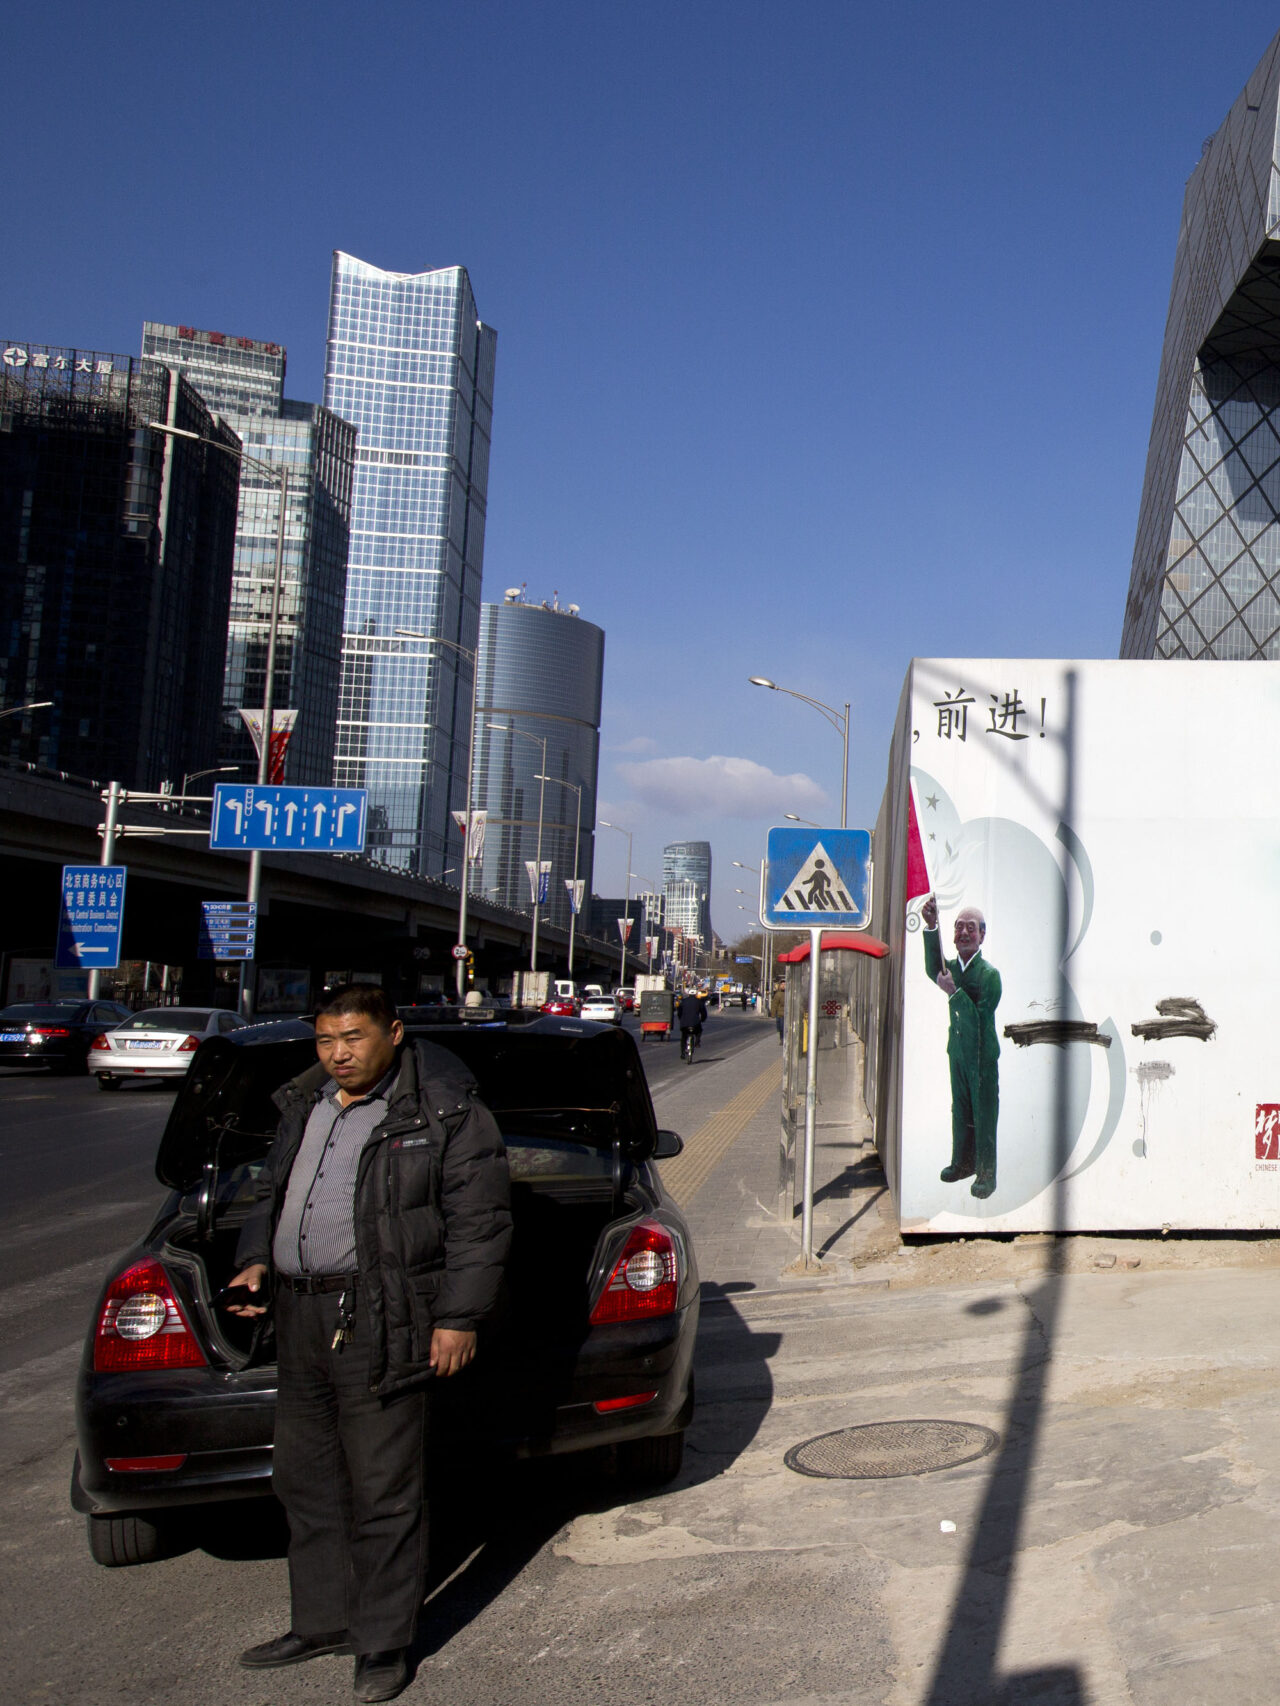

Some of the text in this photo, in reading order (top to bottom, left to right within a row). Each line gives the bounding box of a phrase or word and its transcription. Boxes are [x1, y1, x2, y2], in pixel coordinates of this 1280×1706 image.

[32, 353, 113, 375] 富尔大厦
[65, 873, 123, 888] 北京商务中心区
[65, 891, 118, 907] 管理委员会
[249, 904, 255, 913] P
[248, 919, 254, 928] P
[247, 933, 253, 942] P
[246, 948, 252, 957] P
[1255, 1163, 1278, 1172] CHINESE
